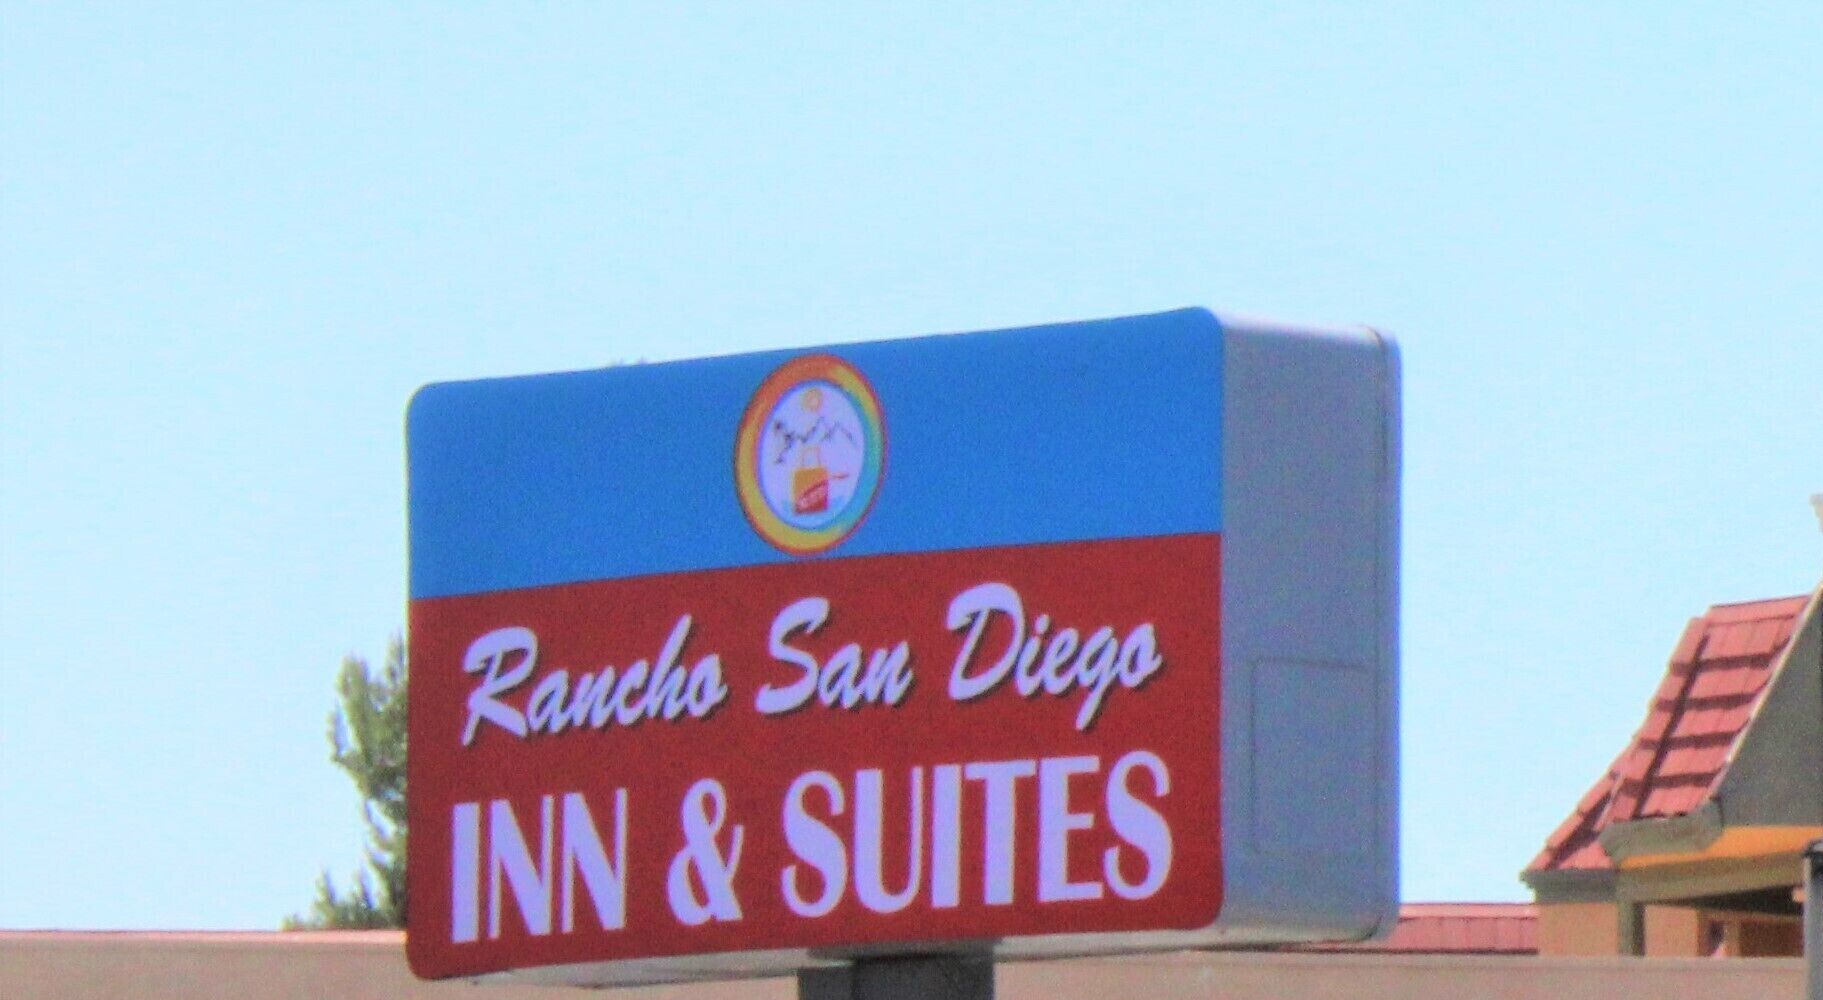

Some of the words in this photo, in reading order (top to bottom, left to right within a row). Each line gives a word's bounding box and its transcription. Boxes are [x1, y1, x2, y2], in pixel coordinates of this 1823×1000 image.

[462, 614, 727, 747] Rancho
[756, 596, 915, 714] San
[946, 582, 1162, 731] Diego
[452, 788, 628, 944] INN
[666, 778, 745, 926] &
[780, 750, 1174, 918] SUITES
